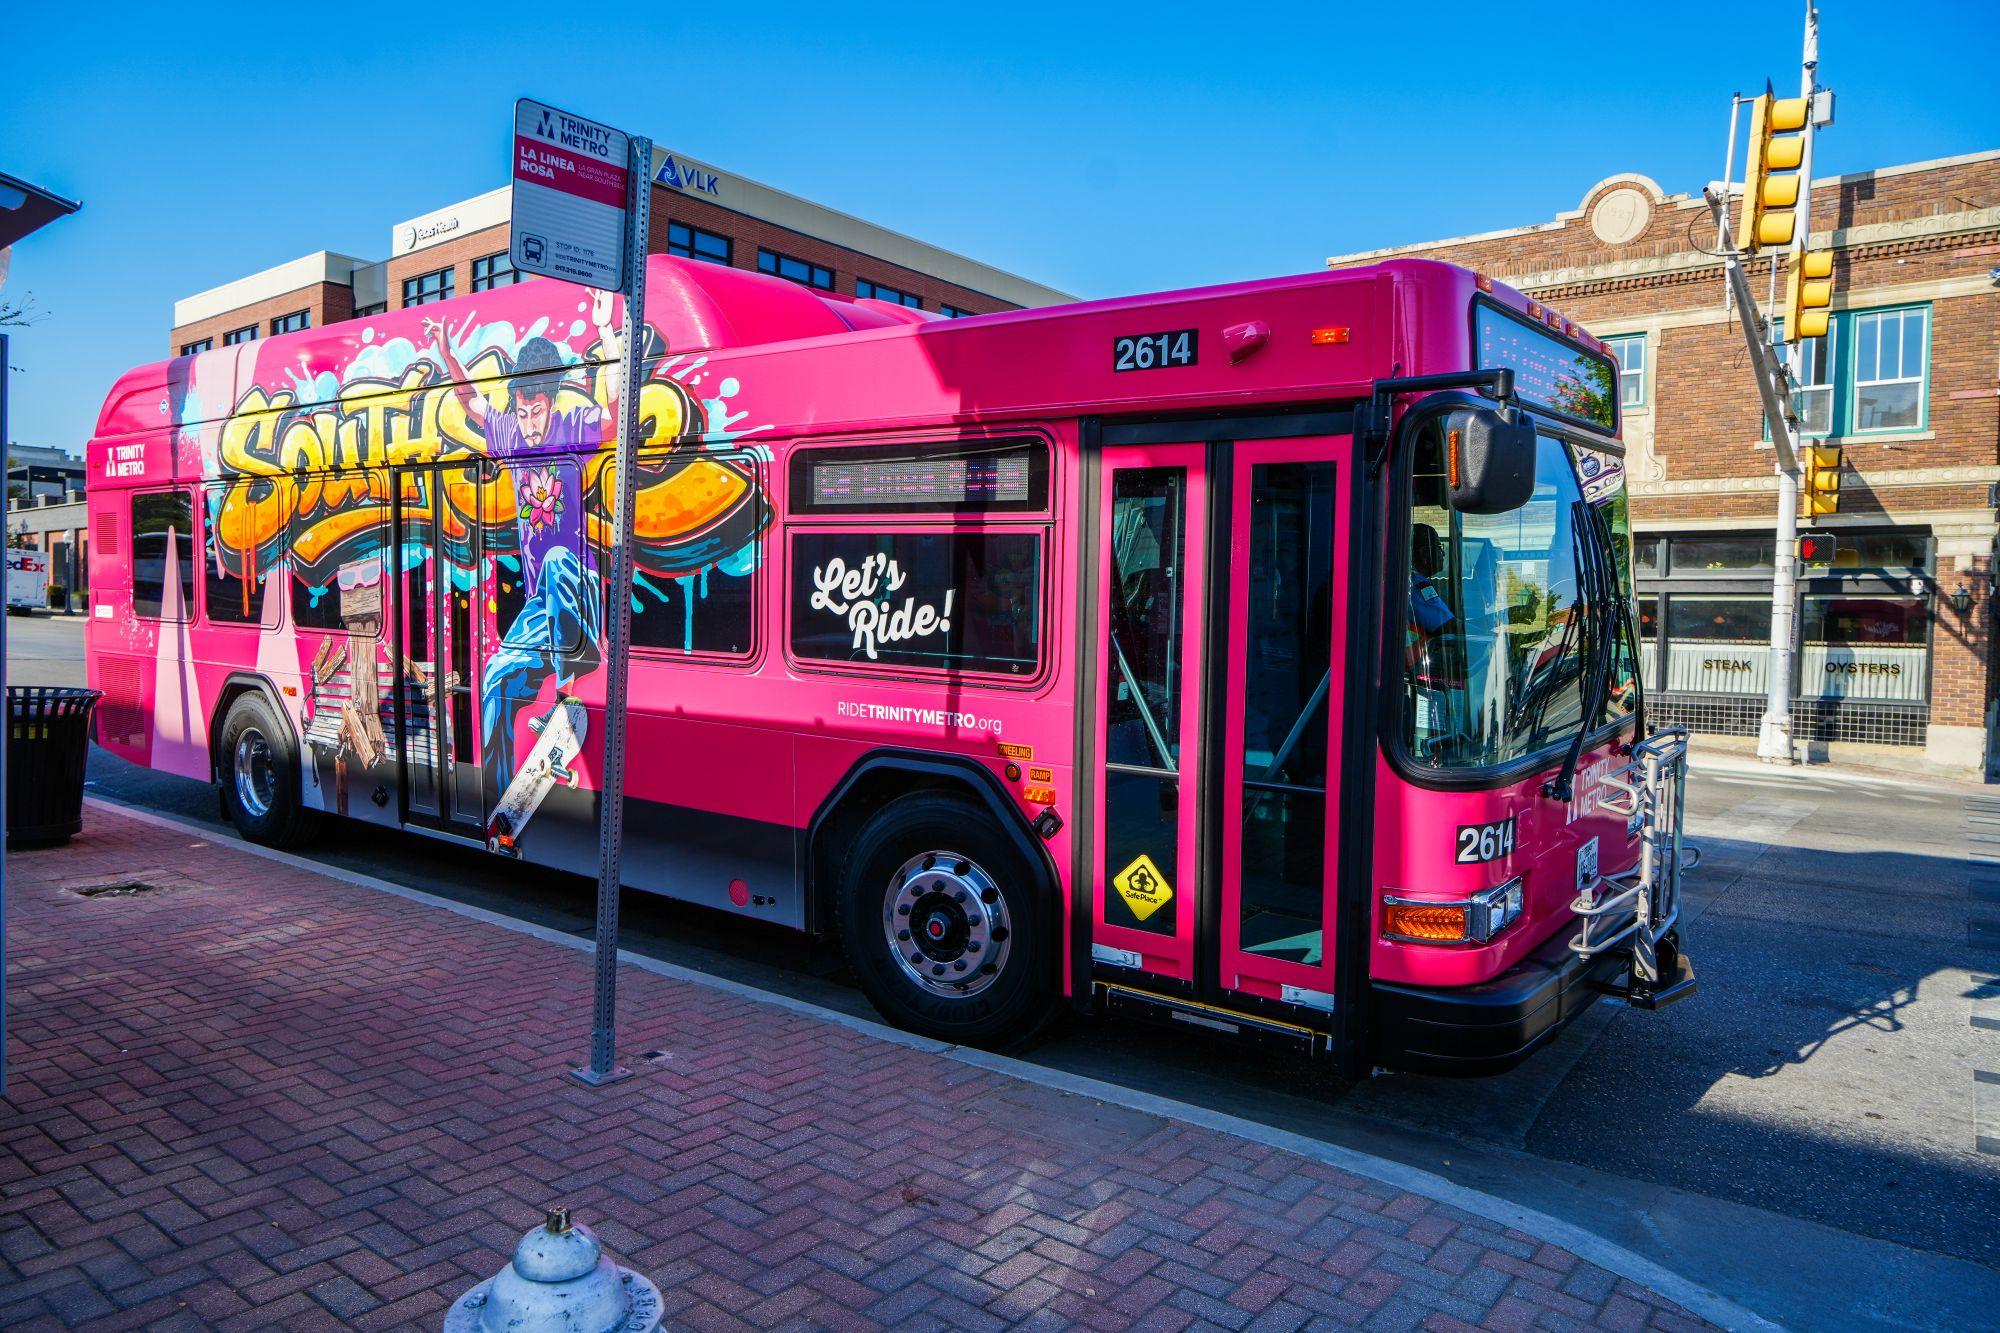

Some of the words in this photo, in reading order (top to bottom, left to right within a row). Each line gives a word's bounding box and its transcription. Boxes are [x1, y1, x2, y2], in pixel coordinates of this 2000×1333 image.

[559, 116, 611, 143] TRINITY
[561, 131, 608, 157] METRO
[521, 146, 537, 160] LA
[540, 152, 576, 173] LINEA
[521, 160, 555, 179] ROSA
[578, 164, 586, 172] LA
[587, 166, 604, 177] GRAN
[604, 171, 621, 182] PLAZA
[578, 171, 594, 181] NEAR
[679, 164, 719, 195] VLK
[556, 242, 572, 250] STOP
[1116, 332, 1191, 371] 2614
[116, 443, 145, 460] TRINITY
[117, 460, 145, 477] METRO
[6, 557, 46, 573] edEx
[810, 552, 907, 615] Let's
[848, 588, 957, 660] Ride!
[1703, 658, 1752, 673] STEAK
[1825, 662, 1901, 676] OYSTERS
[837, 701, 1002, 735] RIDETRINITYMETRO.org
[998, 743, 1031, 758] KNEELING
[1030, 768, 1050, 780] RAMP
[1580, 756, 1611, 792] TRINITY
[1580, 784, 1607, 819] METRO
[1457, 820, 1513, 862] 2614
